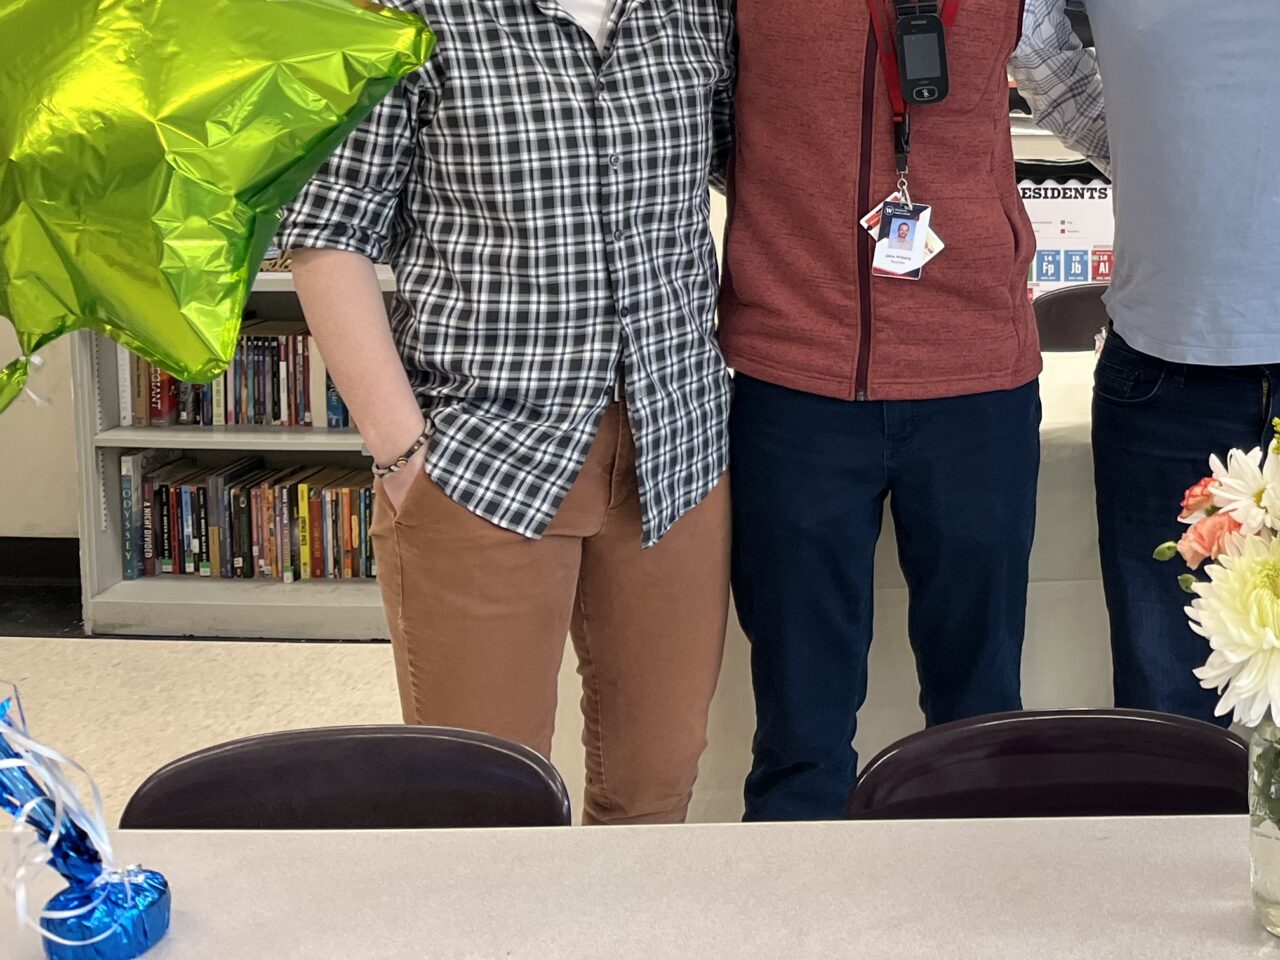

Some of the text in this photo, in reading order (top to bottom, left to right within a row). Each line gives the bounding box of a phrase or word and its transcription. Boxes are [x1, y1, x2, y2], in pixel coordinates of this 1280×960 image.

[1042, 262, 1054, 276] Fp
[1071, 262, 1081, 274] Jb
[122, 489, 132, 560] ODYSSEY
